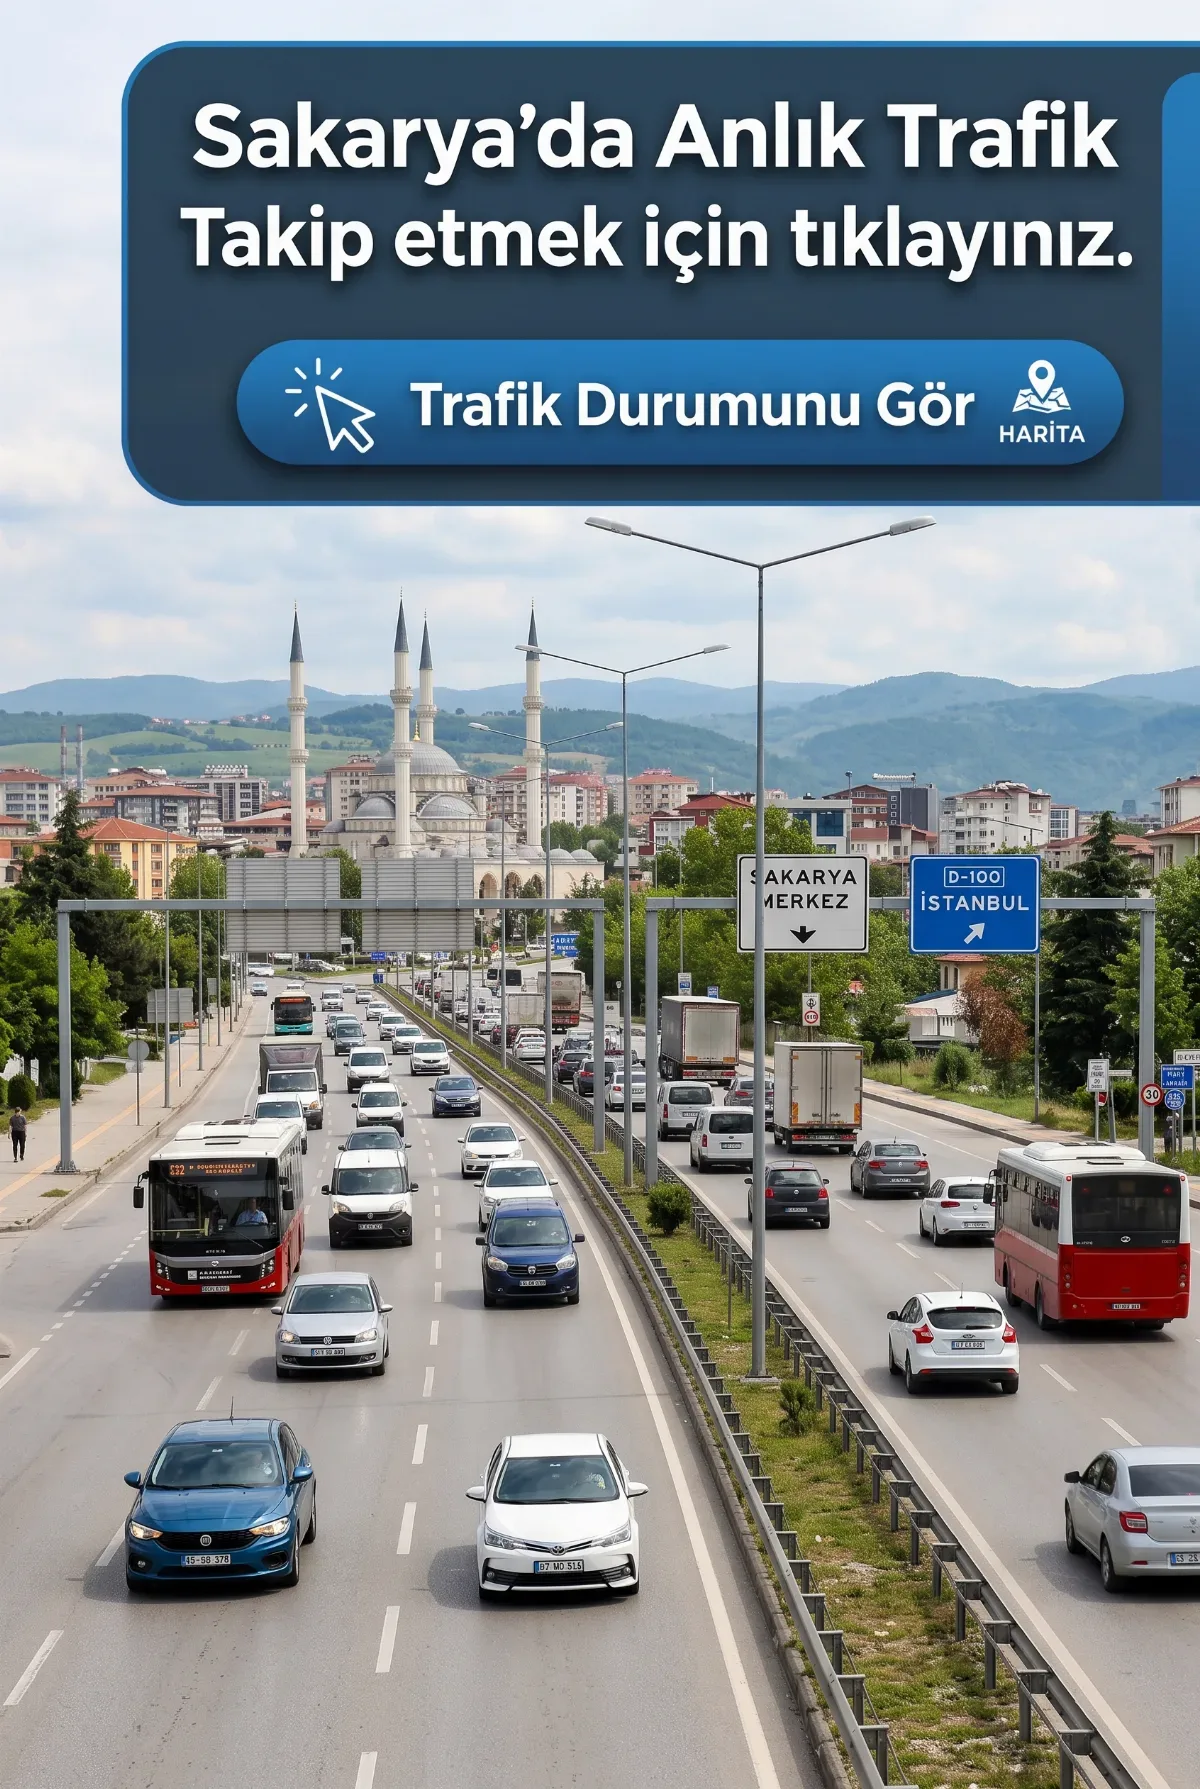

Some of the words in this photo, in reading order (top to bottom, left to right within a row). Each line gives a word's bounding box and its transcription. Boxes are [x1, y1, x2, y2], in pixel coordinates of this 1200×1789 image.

[948, 871, 1001, 884] D-100
[764, 893, 849, 909] MERKEZ
[921, 891, 1030, 911] İSTANBUL
[1145, 1089, 1159, 1100] 30
